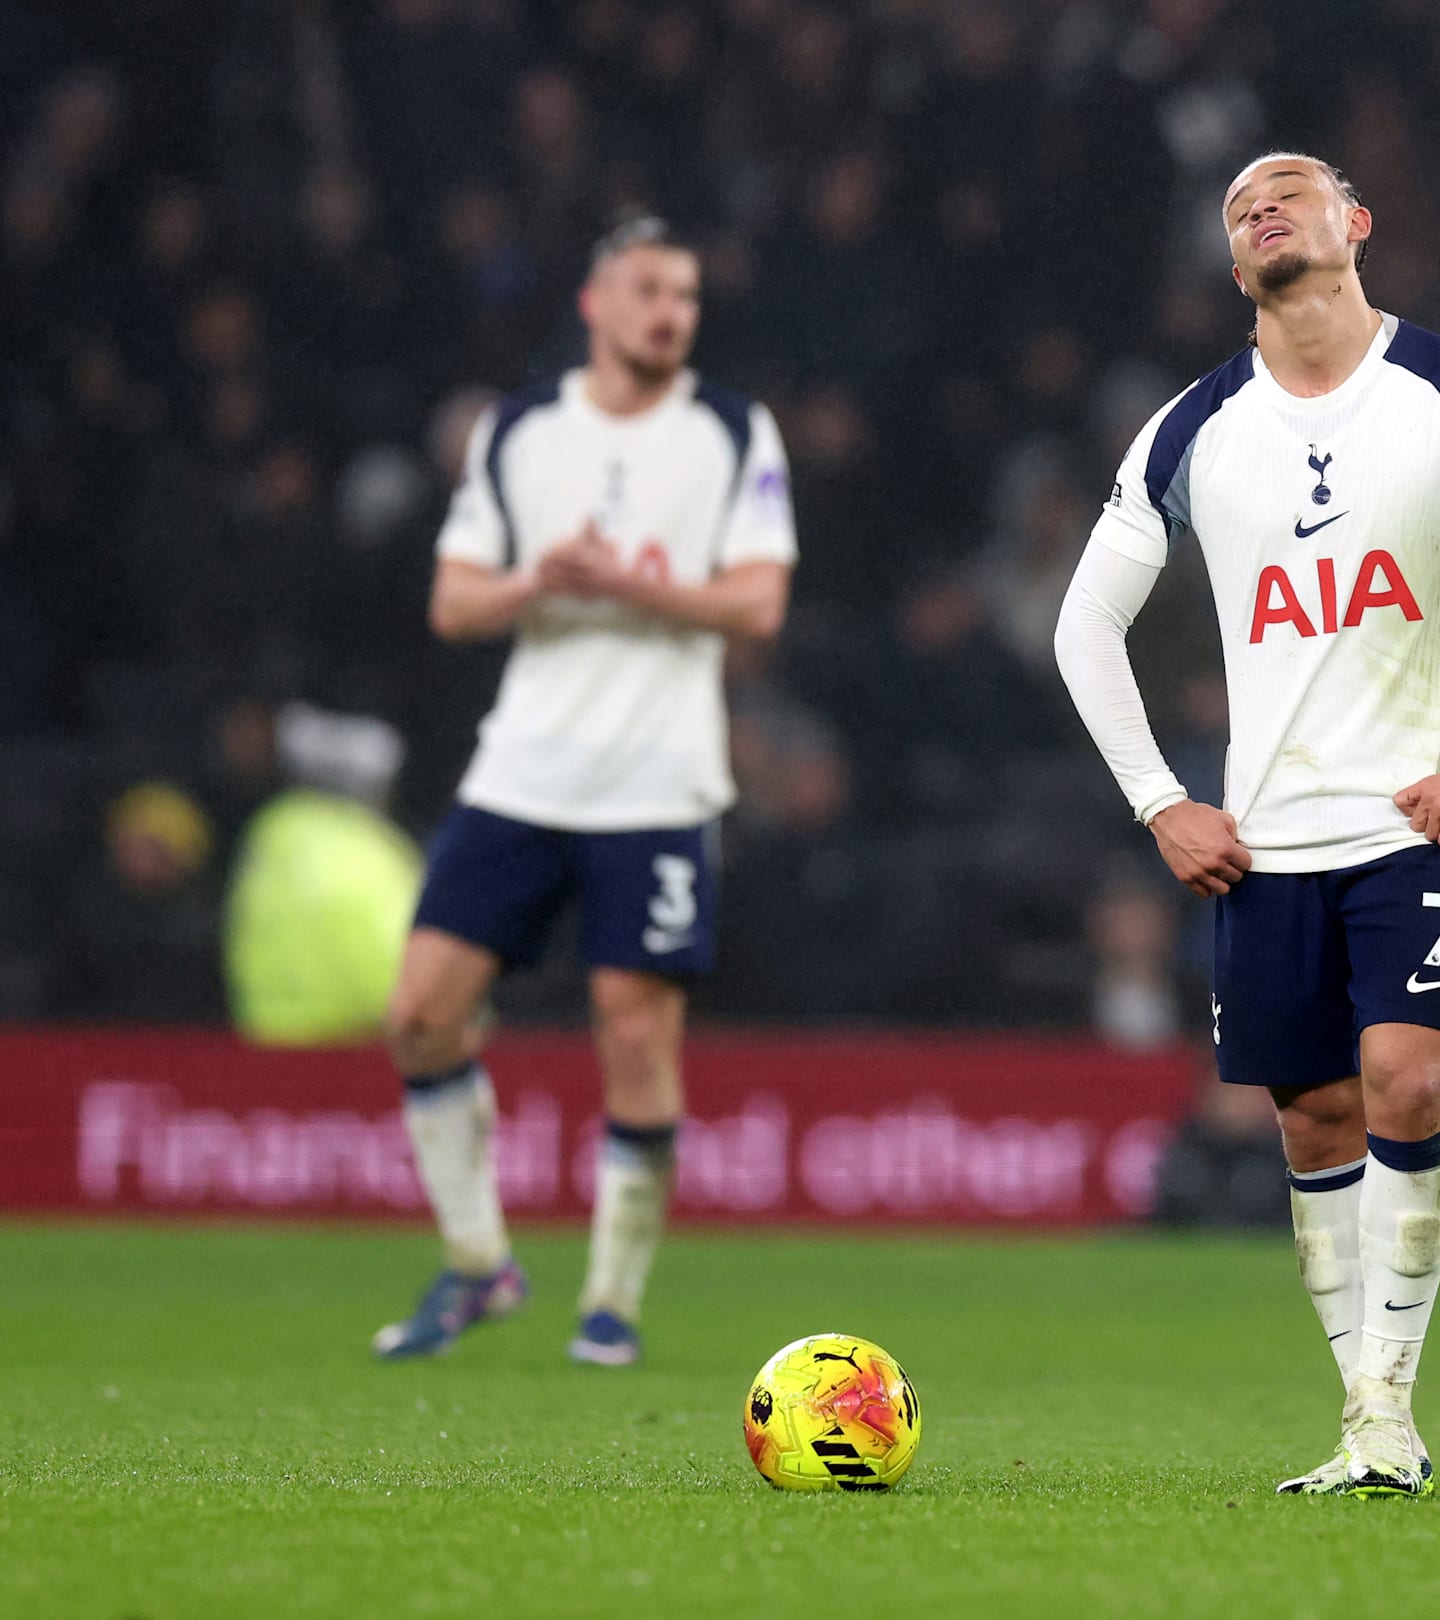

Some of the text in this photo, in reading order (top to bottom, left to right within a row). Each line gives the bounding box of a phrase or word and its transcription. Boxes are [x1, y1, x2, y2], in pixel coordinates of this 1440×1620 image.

[1249, 549, 1425, 644] AIA
[649, 853, 697, 929] 3
[77, 1082, 562, 1205] Financl
[801, 1092, 1094, 1214] other
